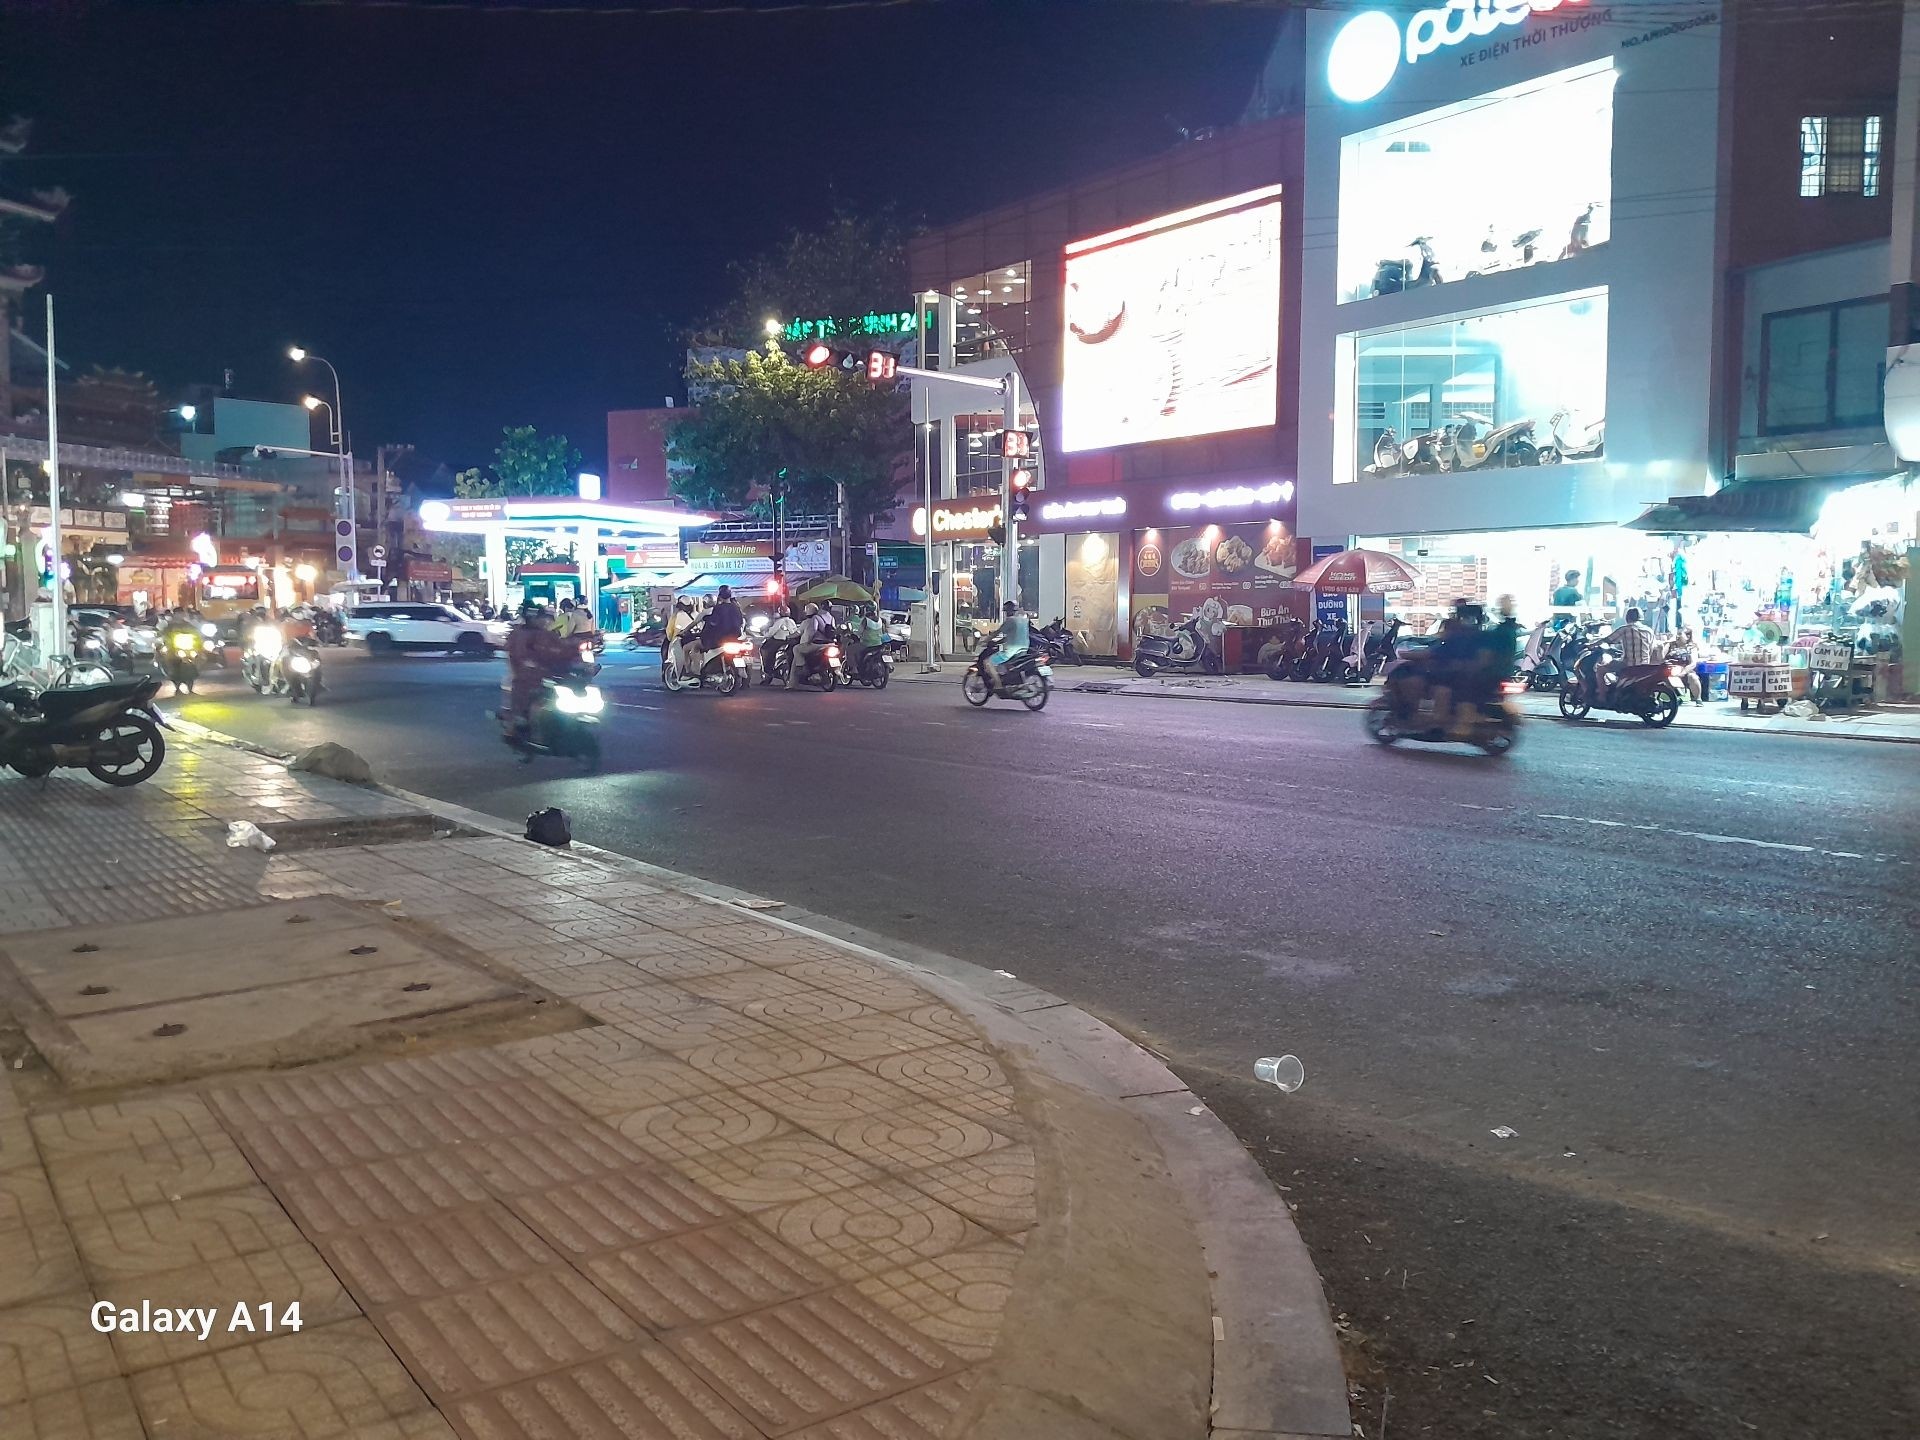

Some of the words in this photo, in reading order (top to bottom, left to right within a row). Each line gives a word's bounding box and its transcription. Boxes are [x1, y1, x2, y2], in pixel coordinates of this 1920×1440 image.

[1460, 53, 1475, 67] XE
[1478, 42, 1510, 61] ĐIỆN
[1512, 29, 1547, 50] THỜI
[933, 504, 1003, 531] Chester'
[722, 545, 757, 555] Havoline
[734, 560, 745, 569] 127
[1318, 600, 1344, 609] DƯỠNG
[1326, 612, 1337, 621] XE
[1814, 647, 1831, 656] CAM
